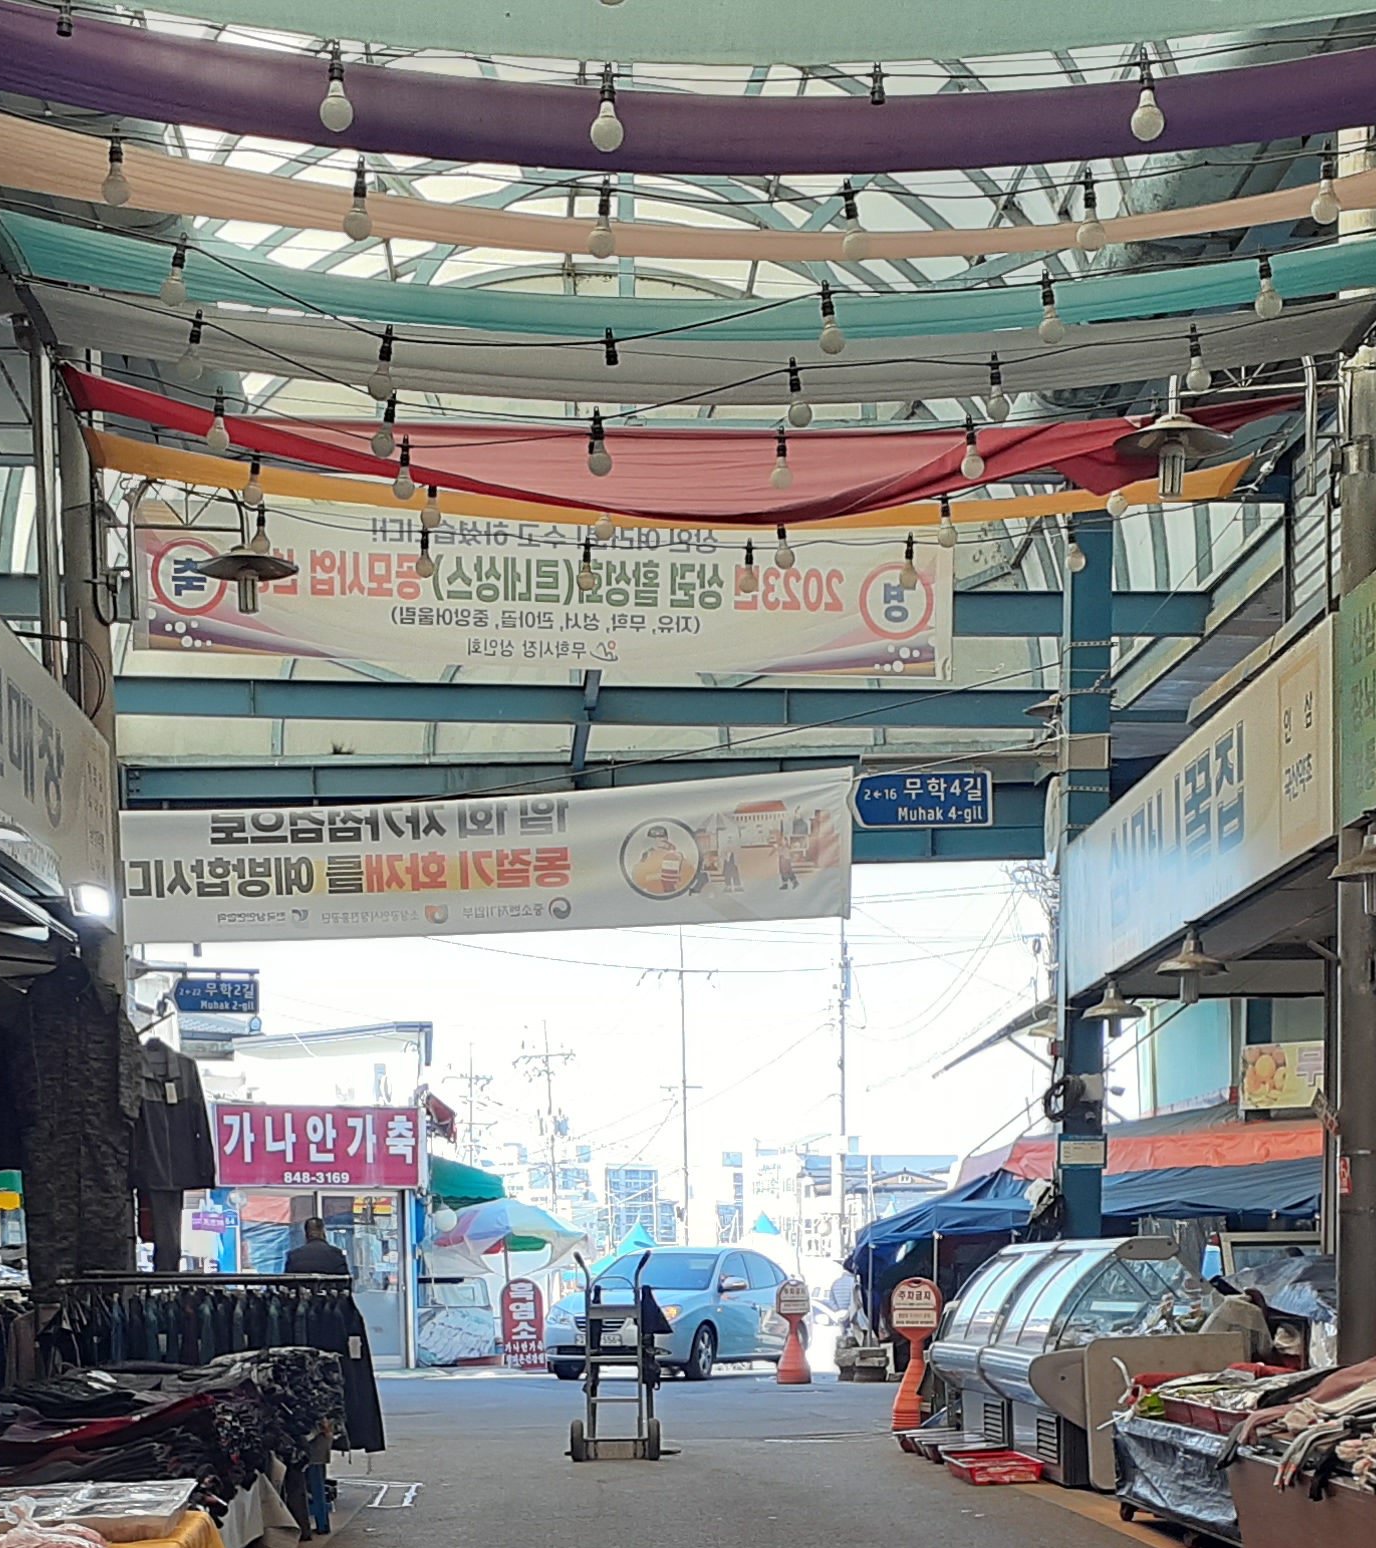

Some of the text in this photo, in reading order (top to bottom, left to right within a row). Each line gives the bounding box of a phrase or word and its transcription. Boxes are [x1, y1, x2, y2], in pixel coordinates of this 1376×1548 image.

[903, 777, 983, 801] 무학4길
[898, 805, 983, 823] Muhak 4-gil
[204, 983, 255, 999] 무학2길
[200, 1000, 255, 1012] Muhak 2-gil
[223, 1112, 416, 1164] 가나안가축
[283, 1172, 350, 1183] 848-3169
[897, 1290, 931, 1301] 주차금지
[509, 1282, 537, 1340] 흑염소
